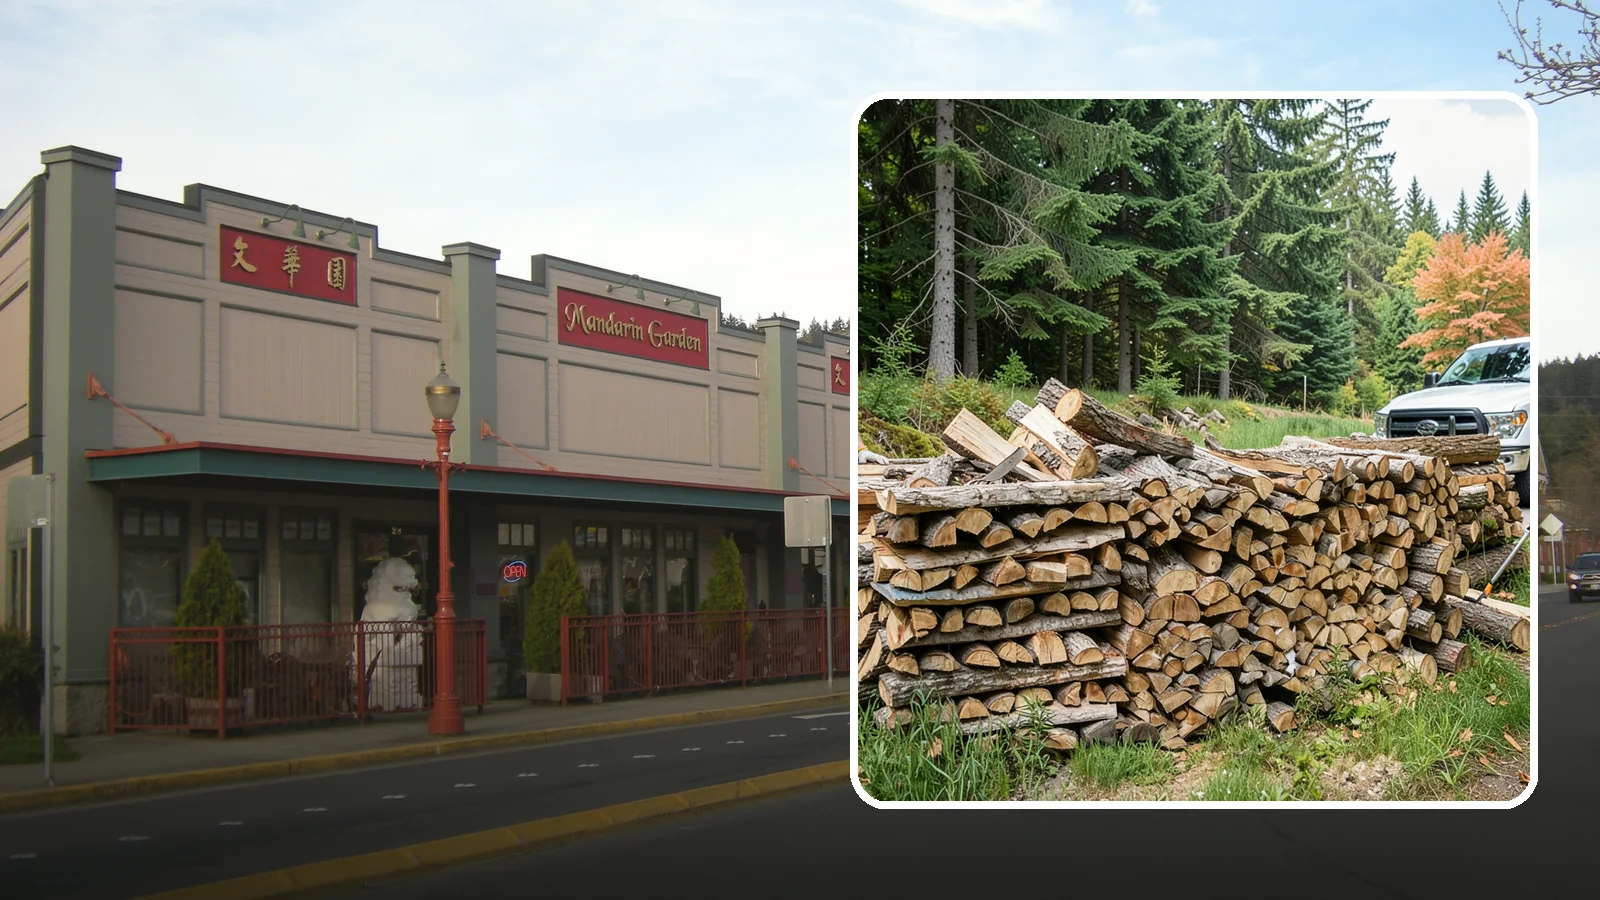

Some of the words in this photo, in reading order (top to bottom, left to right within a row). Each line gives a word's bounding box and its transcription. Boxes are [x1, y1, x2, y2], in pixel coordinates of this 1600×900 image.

[565, 302, 644, 341] Mandarin
[648, 320, 702, 352] Garden
[503, 565, 527, 578] OPEN
